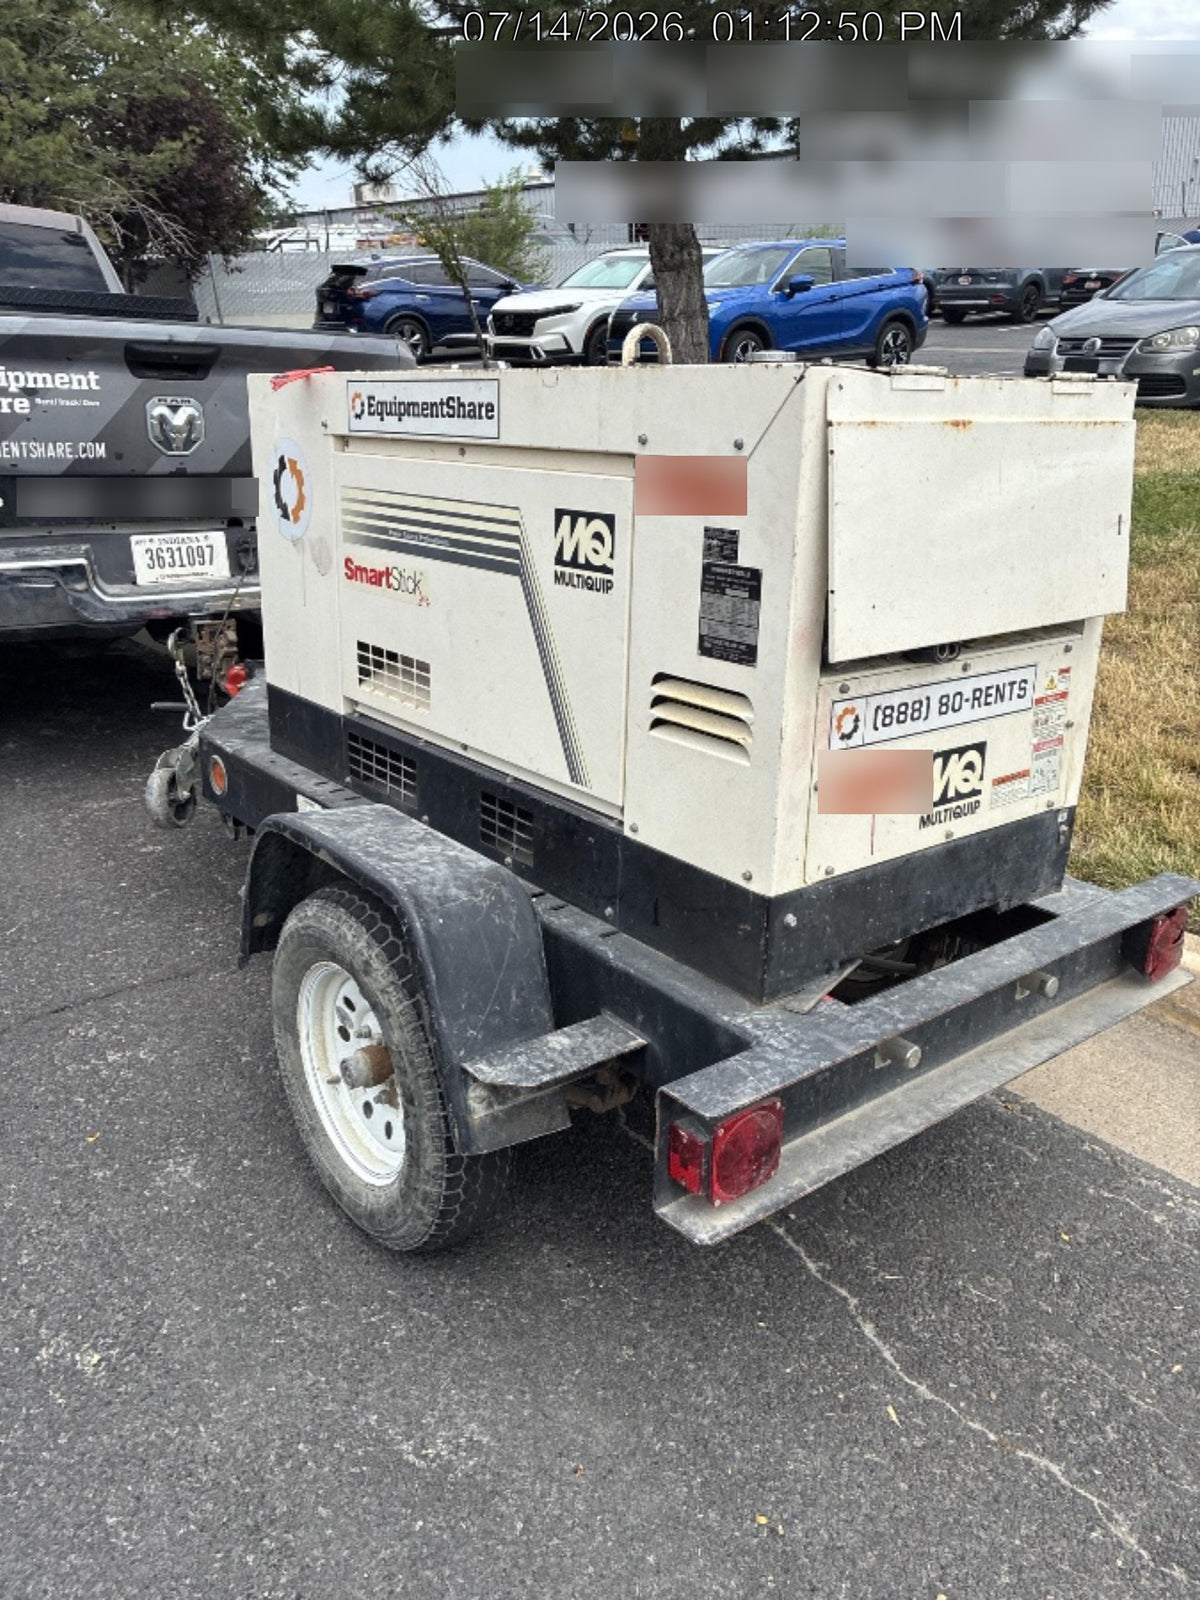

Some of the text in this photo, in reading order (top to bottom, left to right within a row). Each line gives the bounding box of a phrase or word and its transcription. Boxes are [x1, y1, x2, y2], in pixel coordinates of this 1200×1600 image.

[367, 395, 495, 422] EquipmentShare
[0, 441, 106, 459] ENTSHARE.COM
[554, 515, 614, 568] MQ
[145, 544, 214, 569] 3631097
[344, 556, 423, 596] SmartStick
[554, 570, 613, 594] MULTIQUIP
[872, 696, 930, 731] (888)
[938, 679, 1029, 716] 80-RENTS
[919, 800, 981, 830] MULTIQUIP
